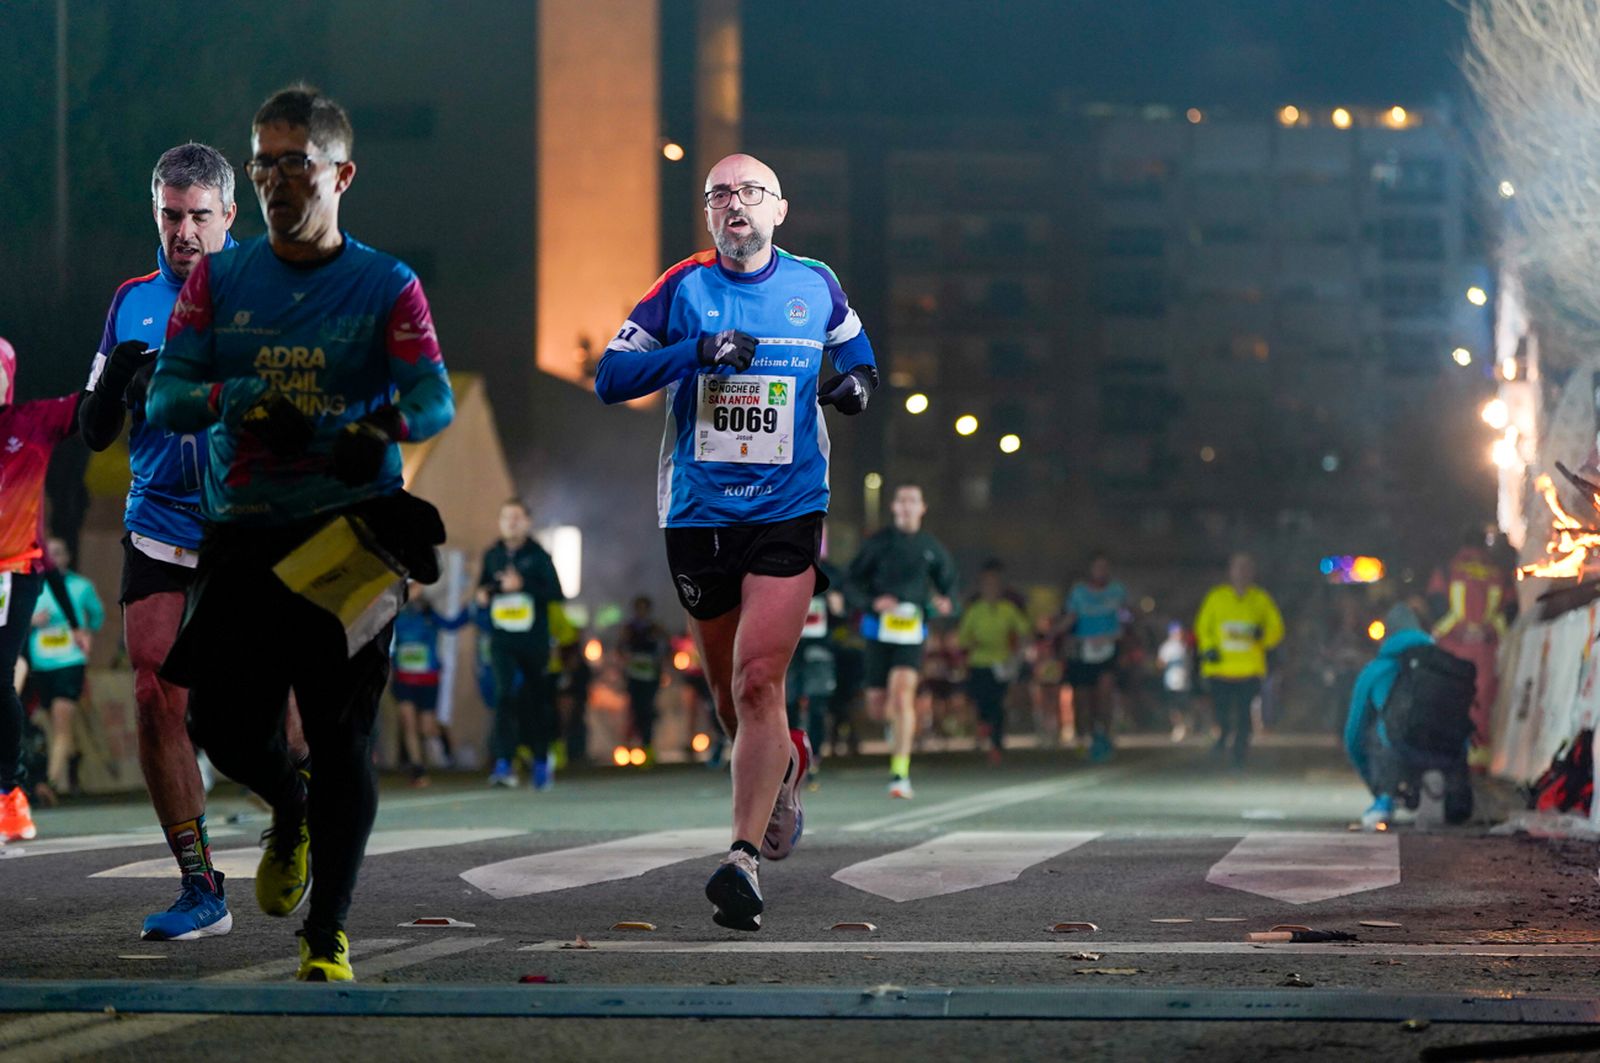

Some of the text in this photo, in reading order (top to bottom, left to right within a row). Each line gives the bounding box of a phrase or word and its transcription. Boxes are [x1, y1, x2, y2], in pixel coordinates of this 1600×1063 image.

[253, 345, 326, 369] ADRA
[256, 369, 323, 393] TRAIL
[719, 384, 747, 394] NOCHE
[749, 384, 760, 394] DE
[708, 394, 727, 405] SAN
[713, 406, 778, 434] 6069
